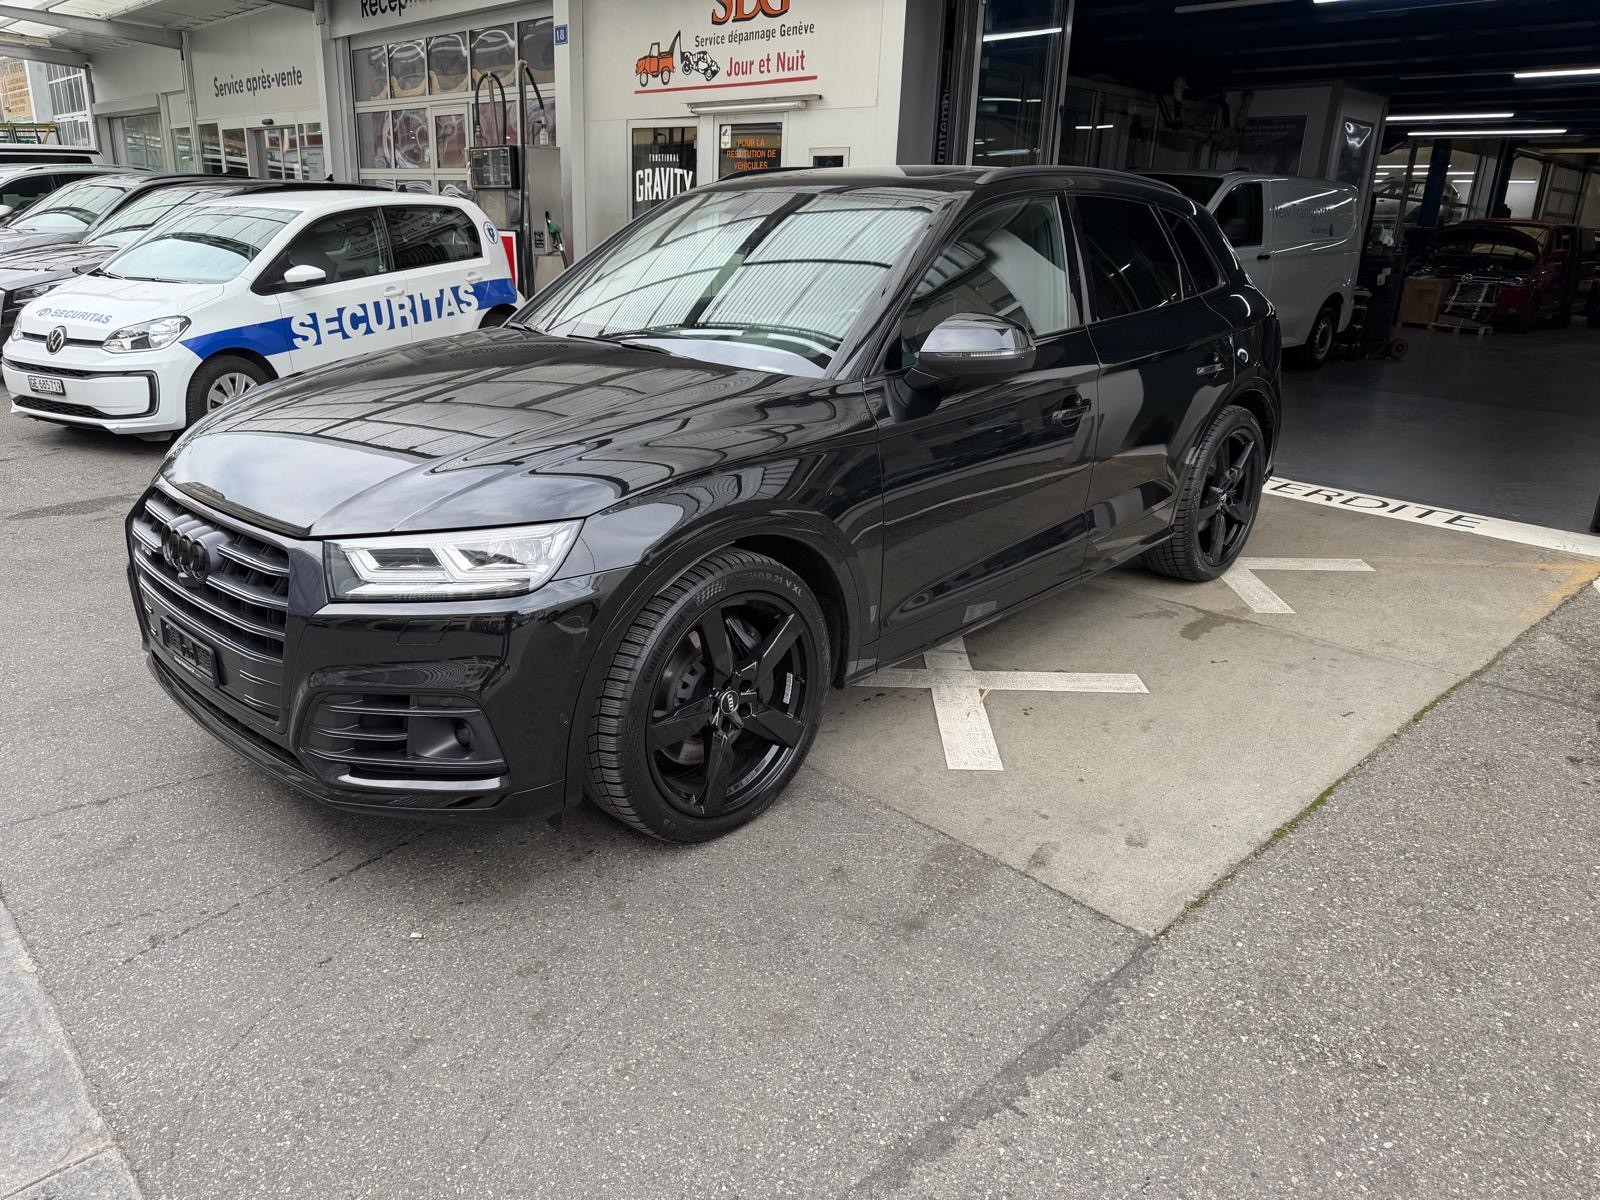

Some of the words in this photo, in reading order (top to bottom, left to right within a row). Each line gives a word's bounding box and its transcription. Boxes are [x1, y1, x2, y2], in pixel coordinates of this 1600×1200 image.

[556, 29, 565, 41] 18
[695, 33, 725, 48] Service
[728, 27, 776, 45] dépannage
[779, 21, 815, 37] Genève
[726, 57, 755, 77] Jour
[758, 53, 771, 74] et
[776, 50, 806, 73] Nuit
[213, 74, 244, 98] Service
[246, 66, 302, 96] après-vente
[737, 138, 755, 147] POUR
[756, 138, 765, 146] LA
[649, 153, 679, 162] FUNCTIONAL
[767, 149, 776, 158] DE
[635, 167, 694, 202] GRAVITY
[1272, 204, 1290, 218] New
[51, 309, 112, 324] SECURITAS
[290, 283, 479, 350] SECURITAS
